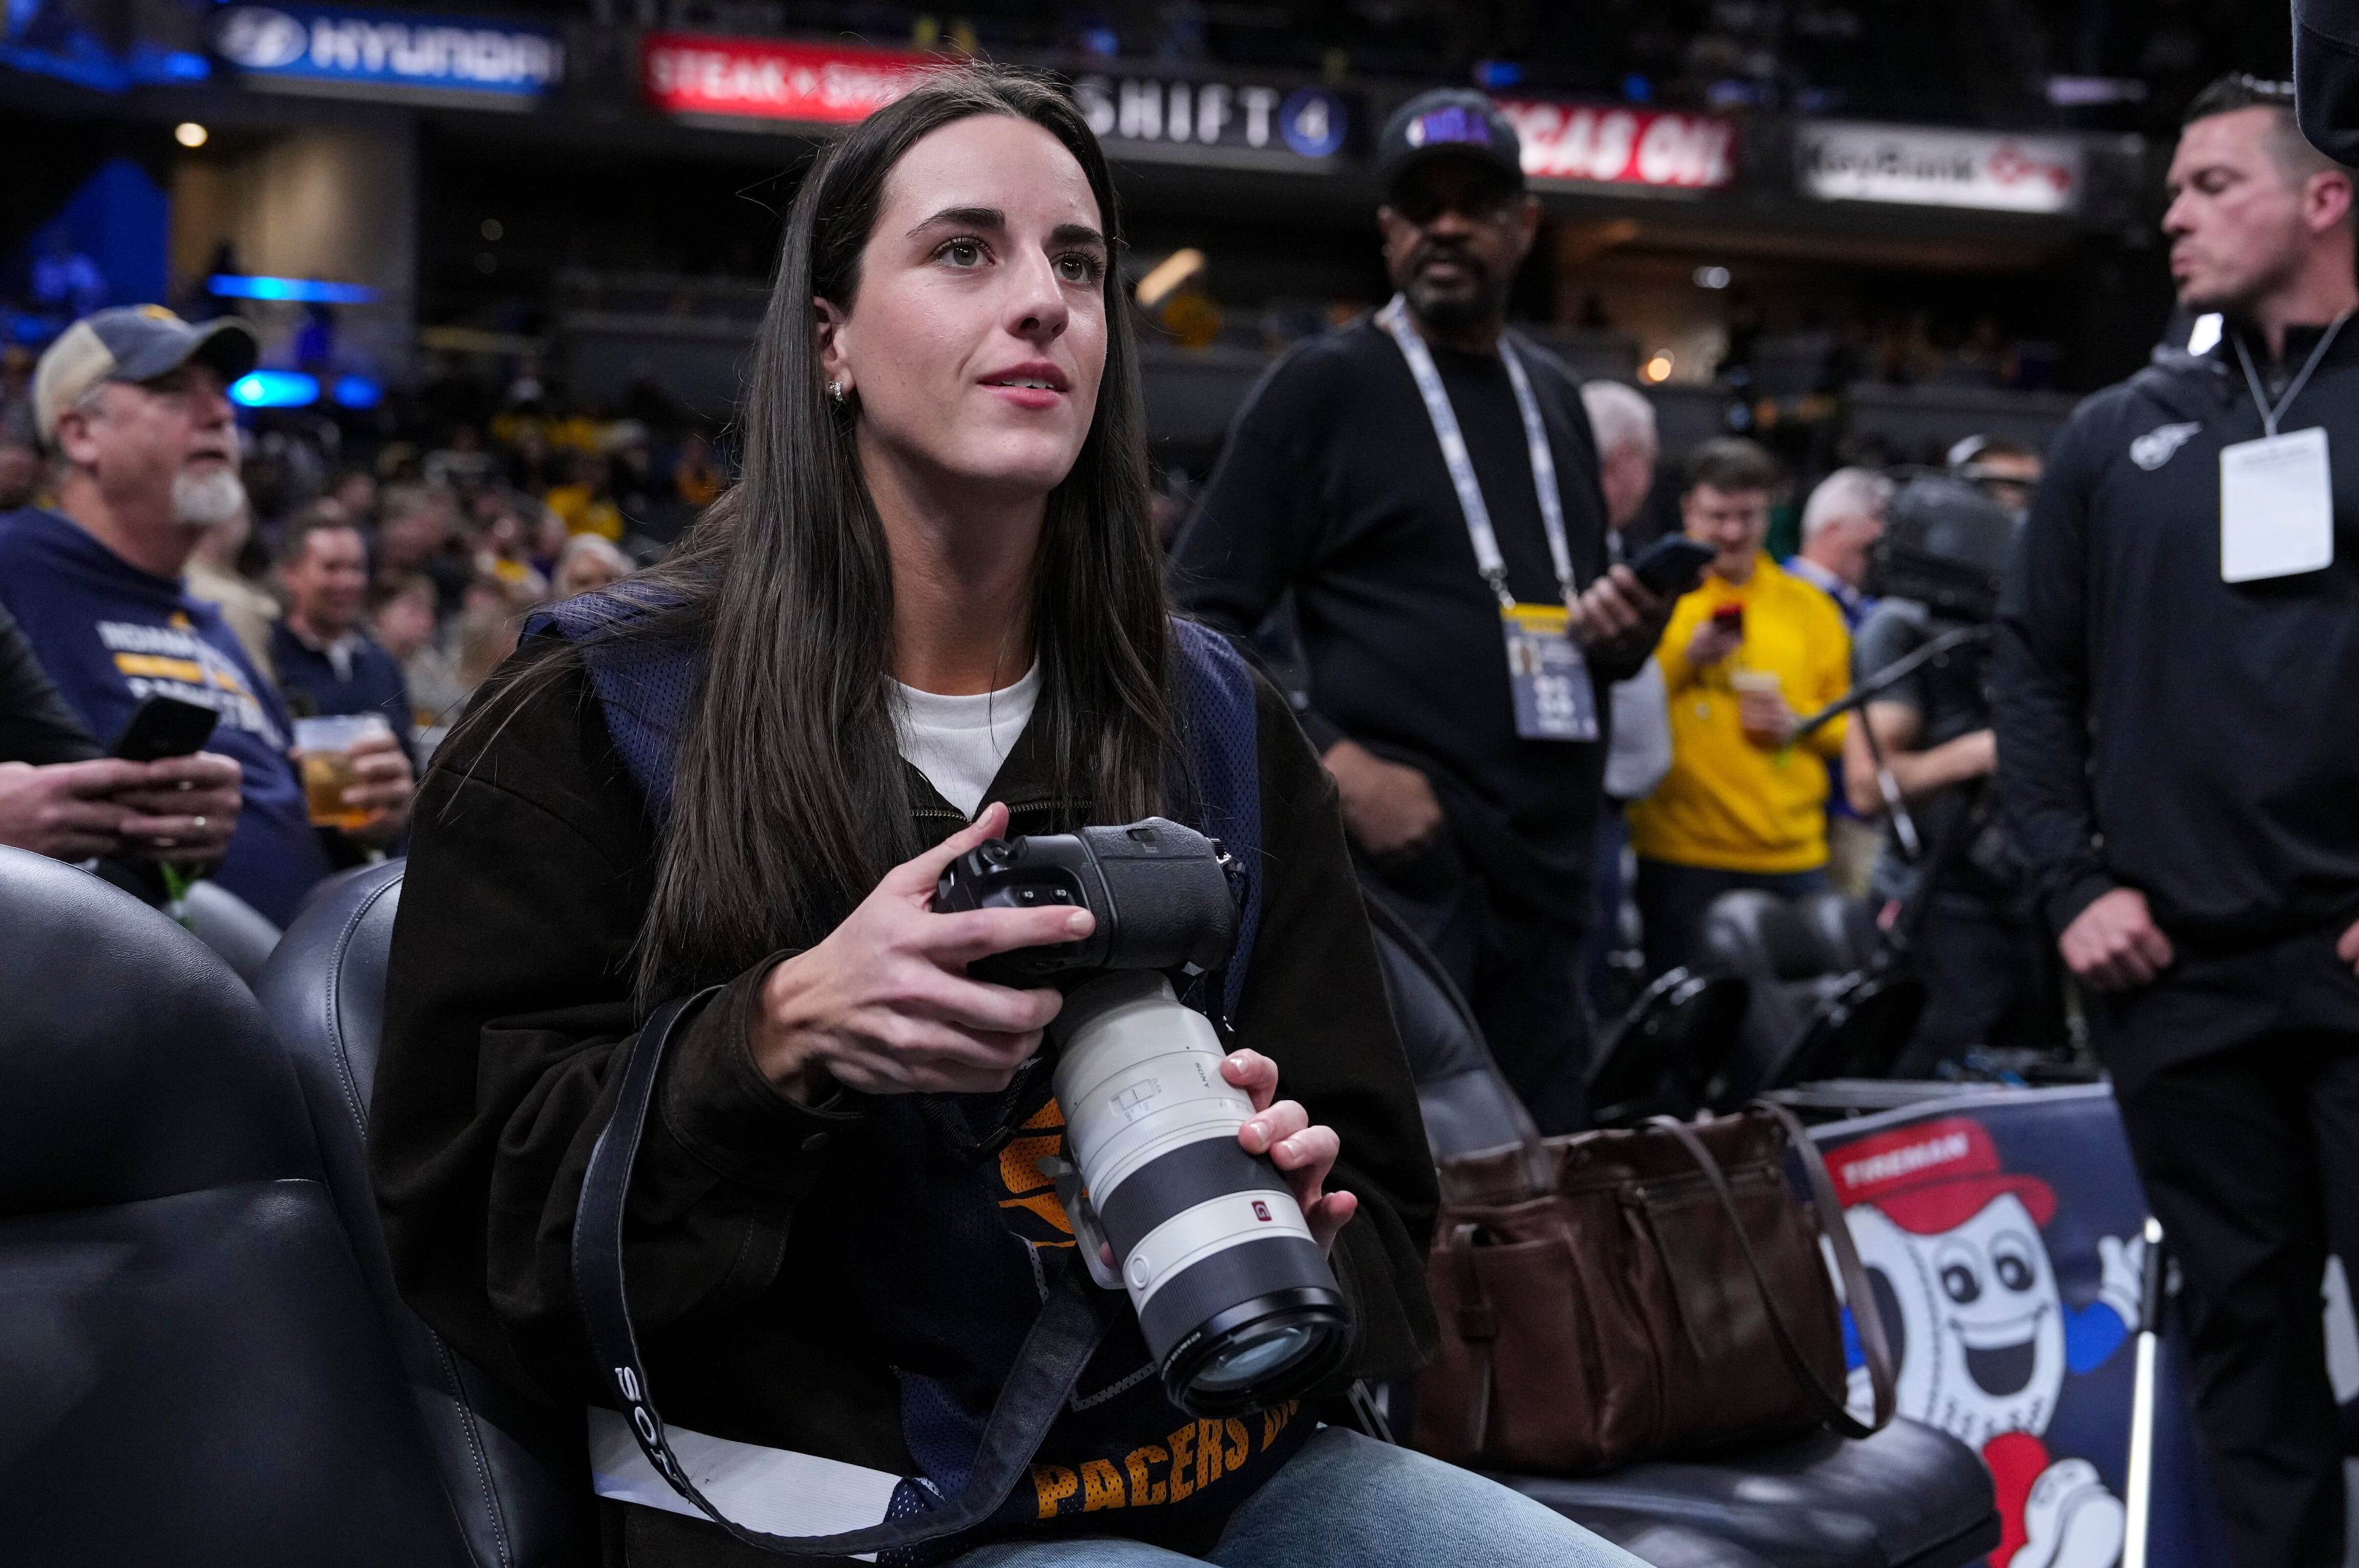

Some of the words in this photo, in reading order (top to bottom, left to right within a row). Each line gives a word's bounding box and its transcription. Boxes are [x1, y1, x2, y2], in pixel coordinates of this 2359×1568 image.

[310, 15, 565, 86] HYUNDAI
[650, 47, 789, 104] STEAK
[1074, 75, 1280, 149] SHIFT
[1194, 1062, 1210, 1088] SONY
[1030, 1418, 1249, 1519] PACERS
